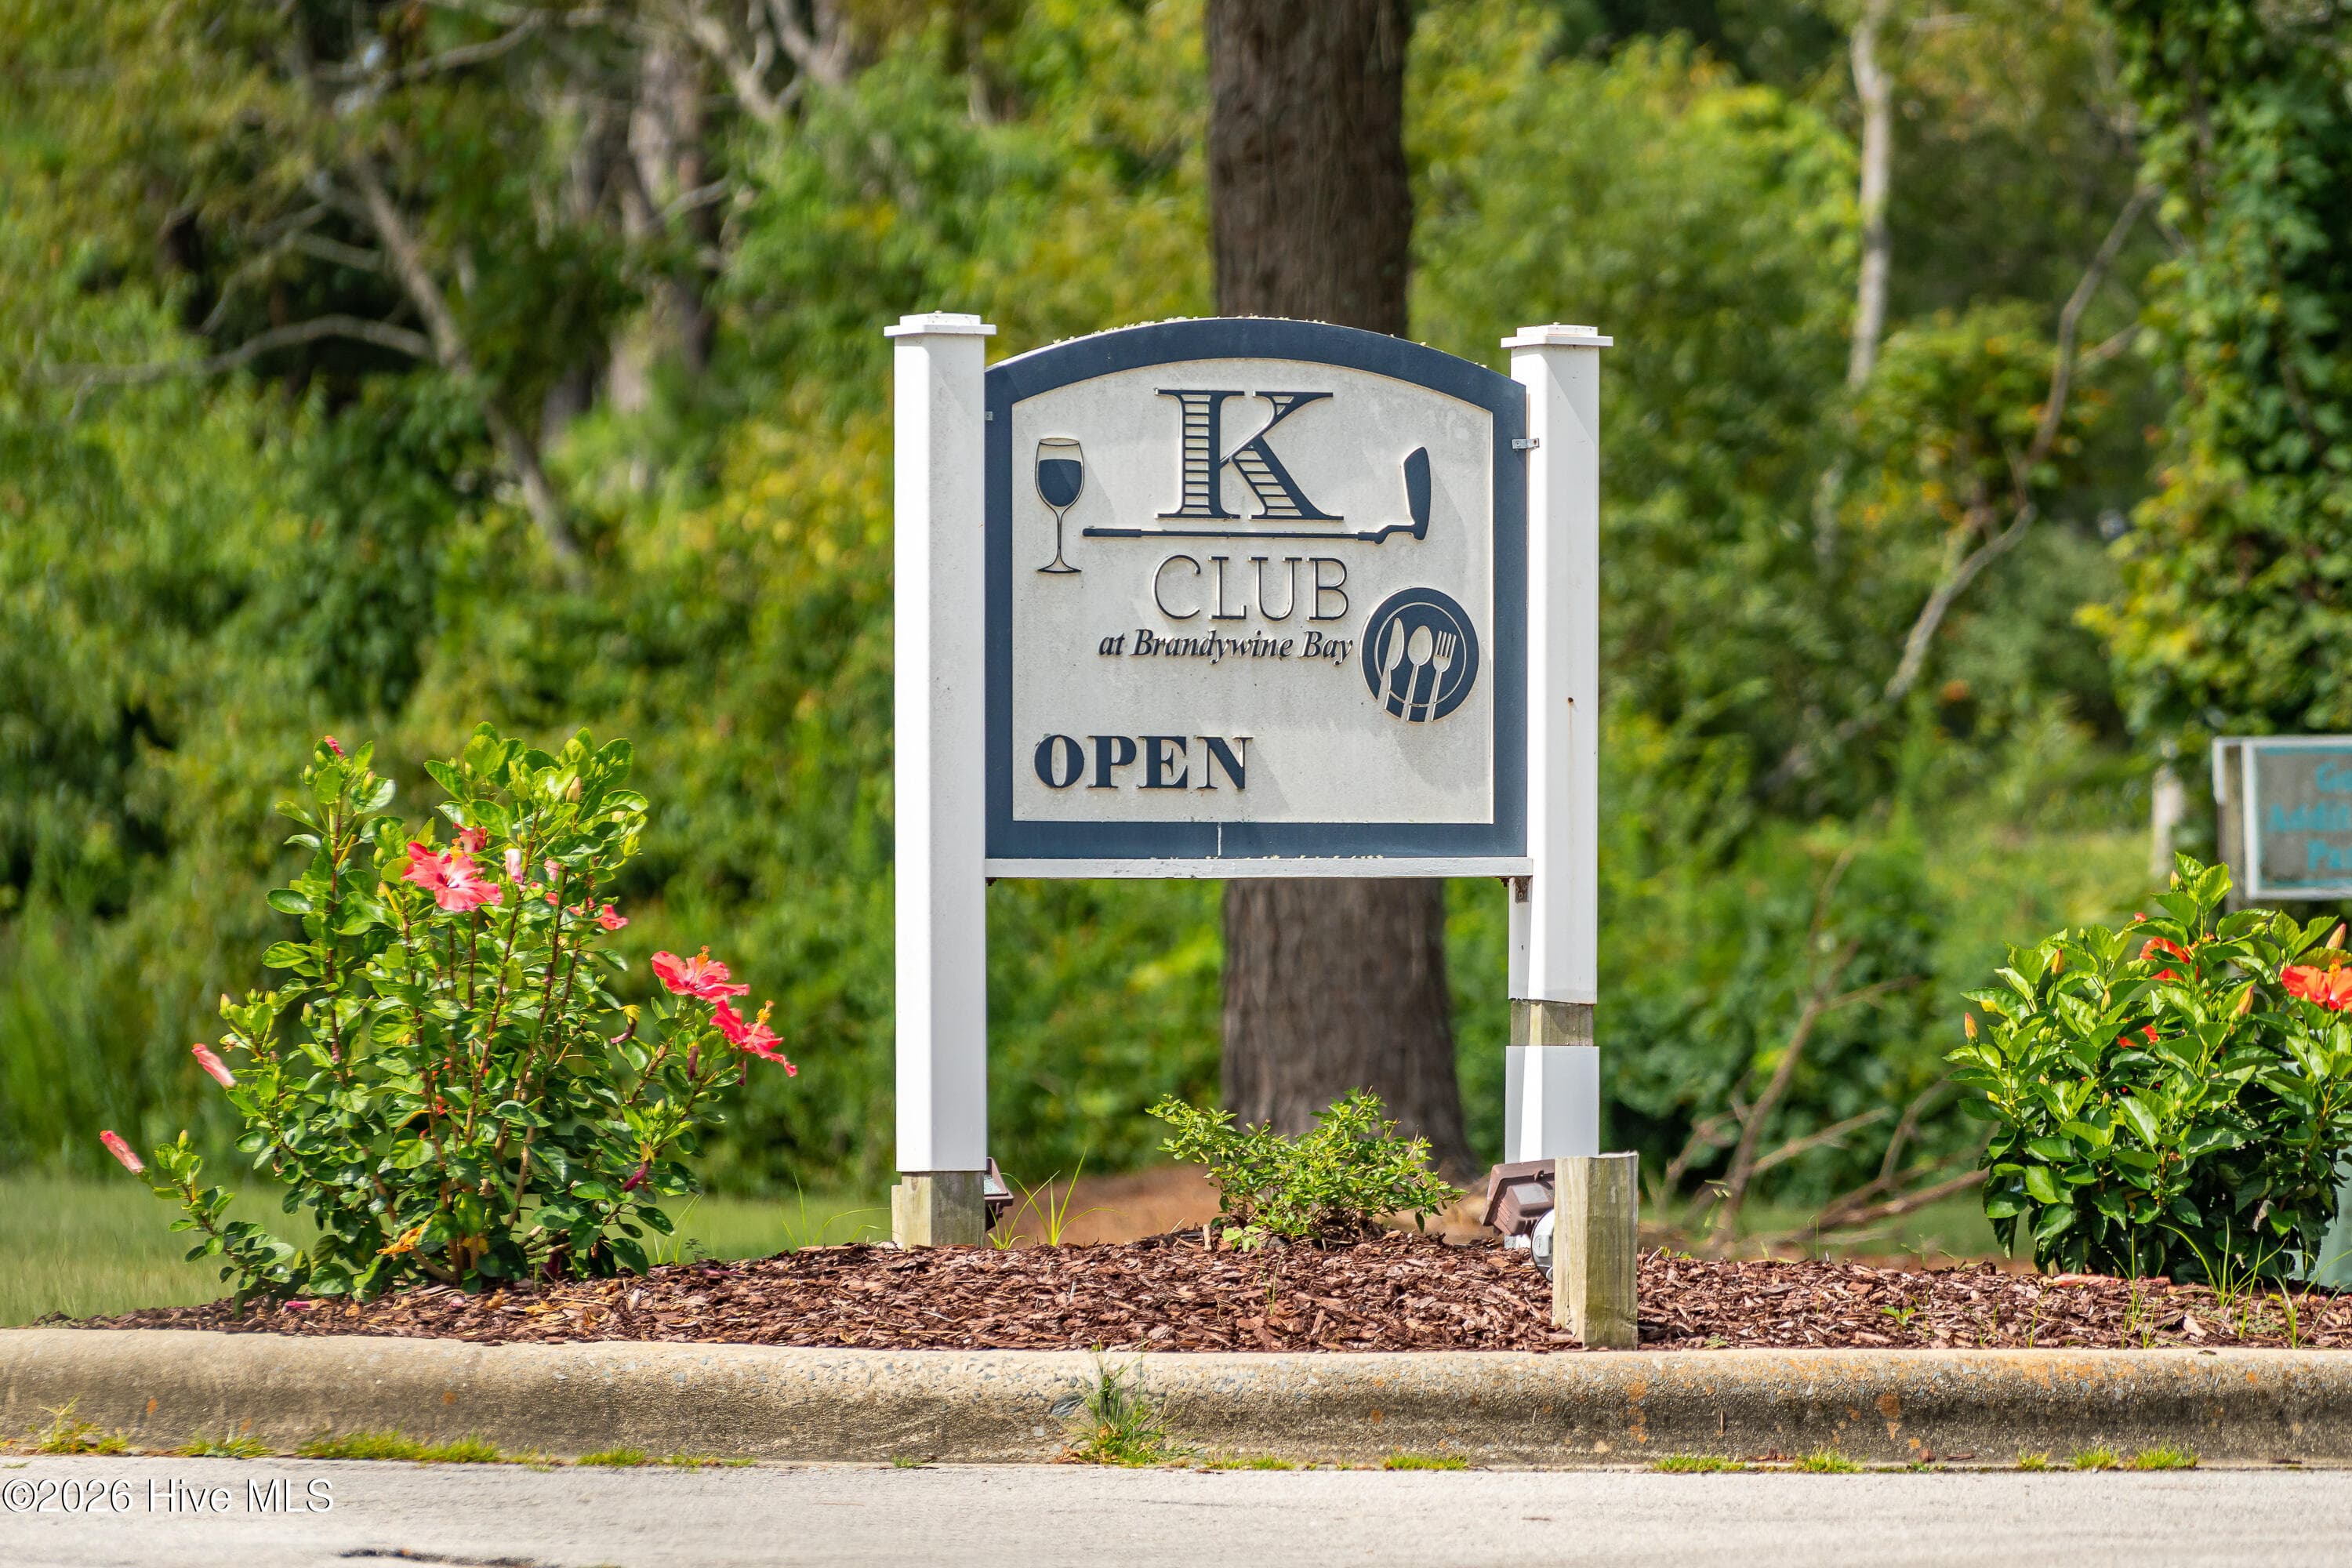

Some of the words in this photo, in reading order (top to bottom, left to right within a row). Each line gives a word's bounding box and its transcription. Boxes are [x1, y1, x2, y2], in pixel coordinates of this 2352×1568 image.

[1155, 389, 1345, 520] K
[1151, 554, 1350, 621] CLUB
[1098, 631, 1125, 657] at
[1130, 628, 1294, 665] Brandywine
[1299, 630, 1352, 666] Bay
[1033, 734, 1253, 790] OPEN
